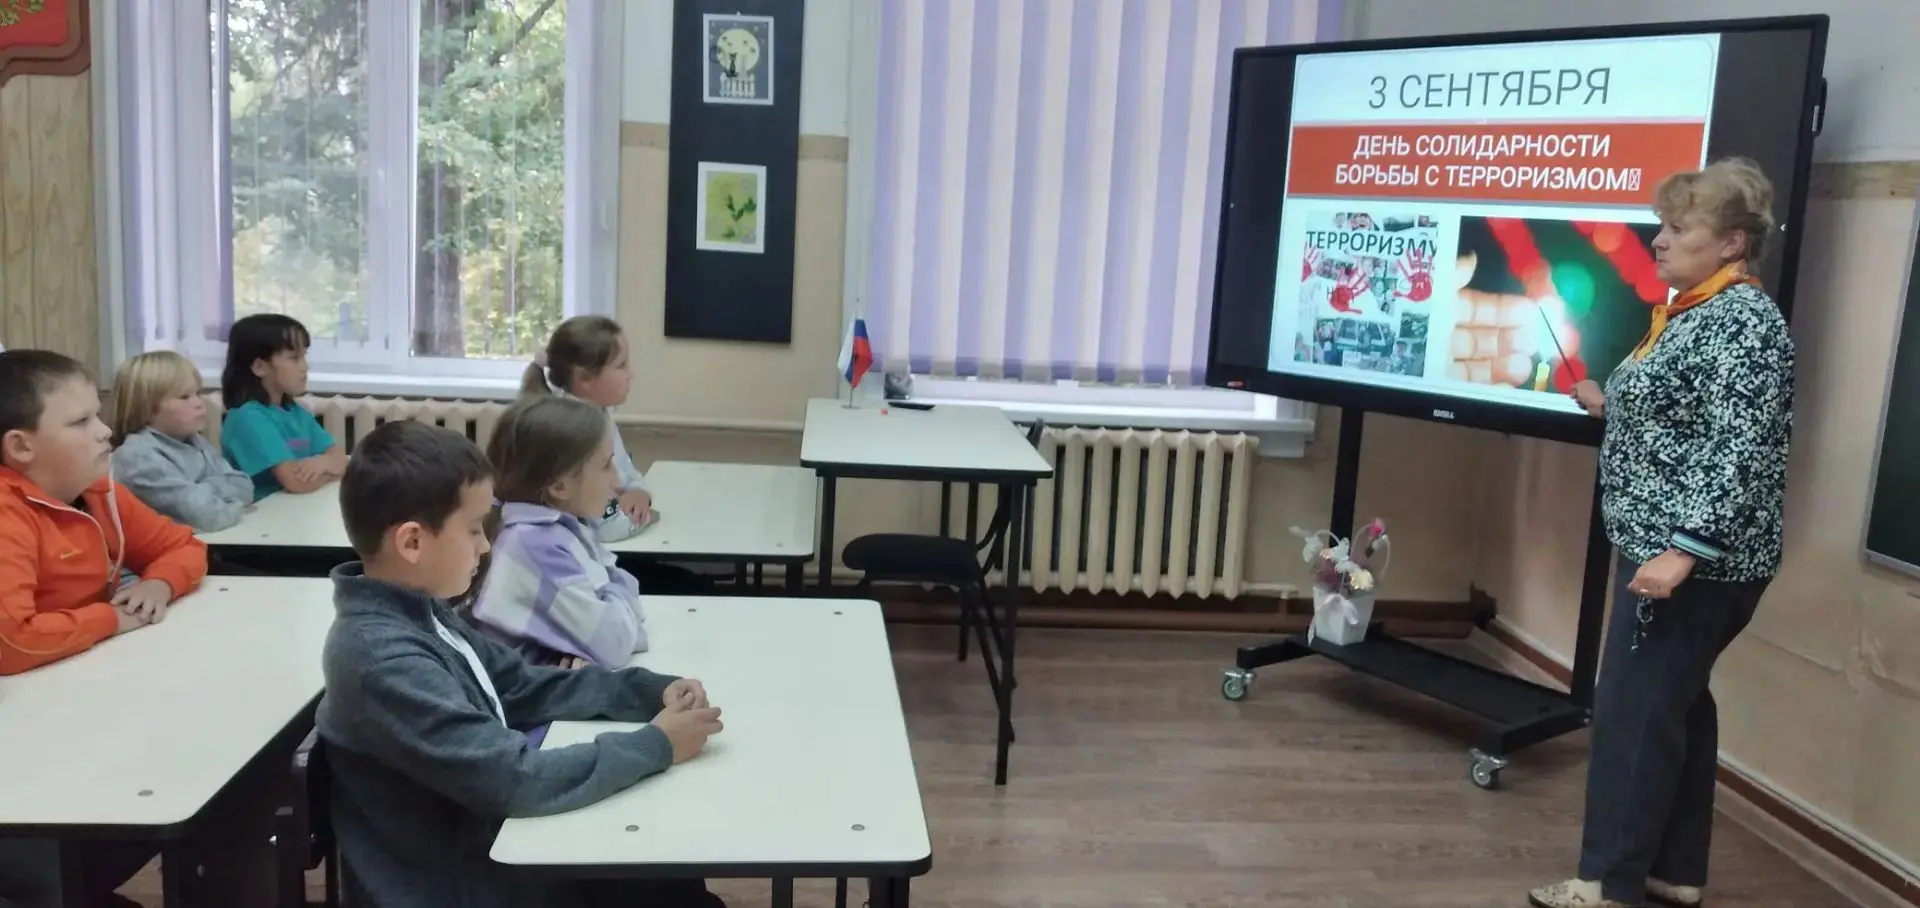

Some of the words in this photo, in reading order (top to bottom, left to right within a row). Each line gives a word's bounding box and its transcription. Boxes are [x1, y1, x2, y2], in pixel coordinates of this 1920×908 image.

[1369, 76, 1387, 108] 3
[1399, 69, 1610, 108] СЕНТЯБРЯ
[1354, 134, 1411, 160] ДЕНЬ
[1415, 134, 1611, 160] СОЛИДАРНОСТИ
[1335, 164, 1419, 186] БОРЬБЫ
[1426, 166, 1440, 186] С
